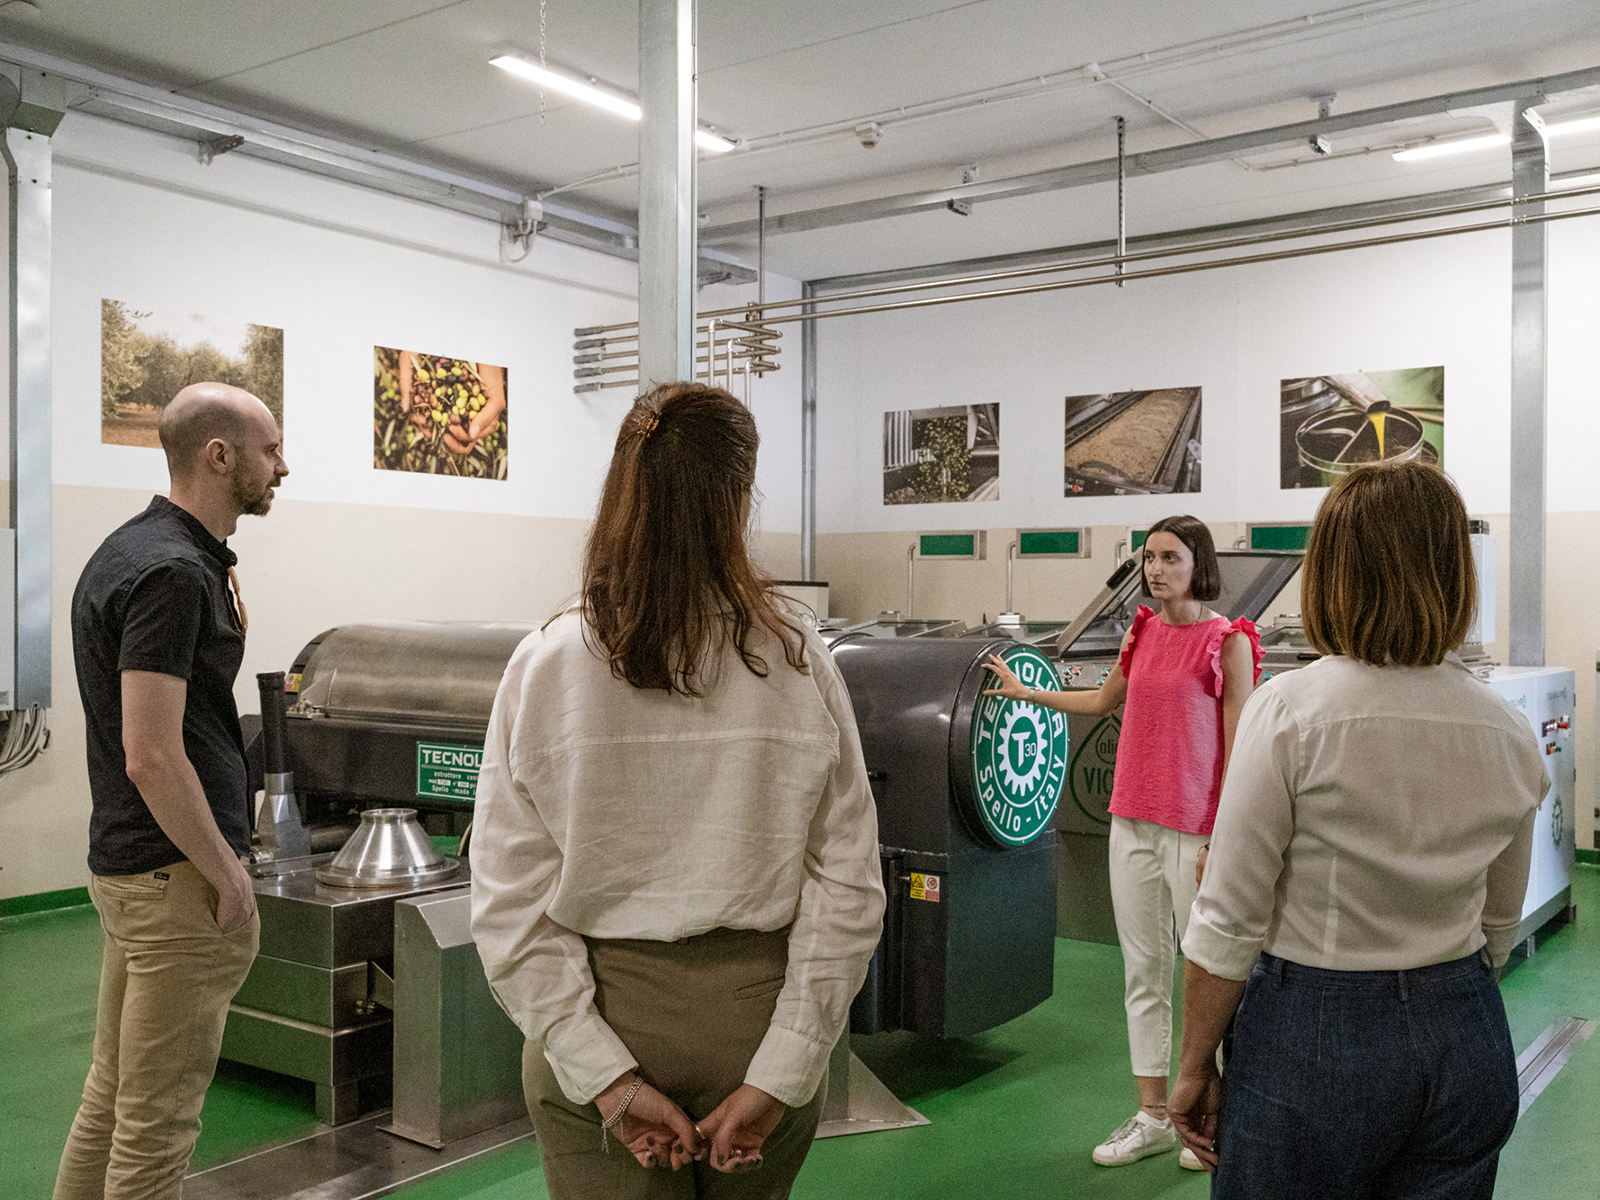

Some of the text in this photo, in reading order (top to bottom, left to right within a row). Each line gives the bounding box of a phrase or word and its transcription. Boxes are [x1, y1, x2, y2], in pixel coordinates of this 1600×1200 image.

[432, 784, 449, 793] Spello
[980, 764, 1021, 832] Spello
[1034, 754, 1065, 820] Italy
